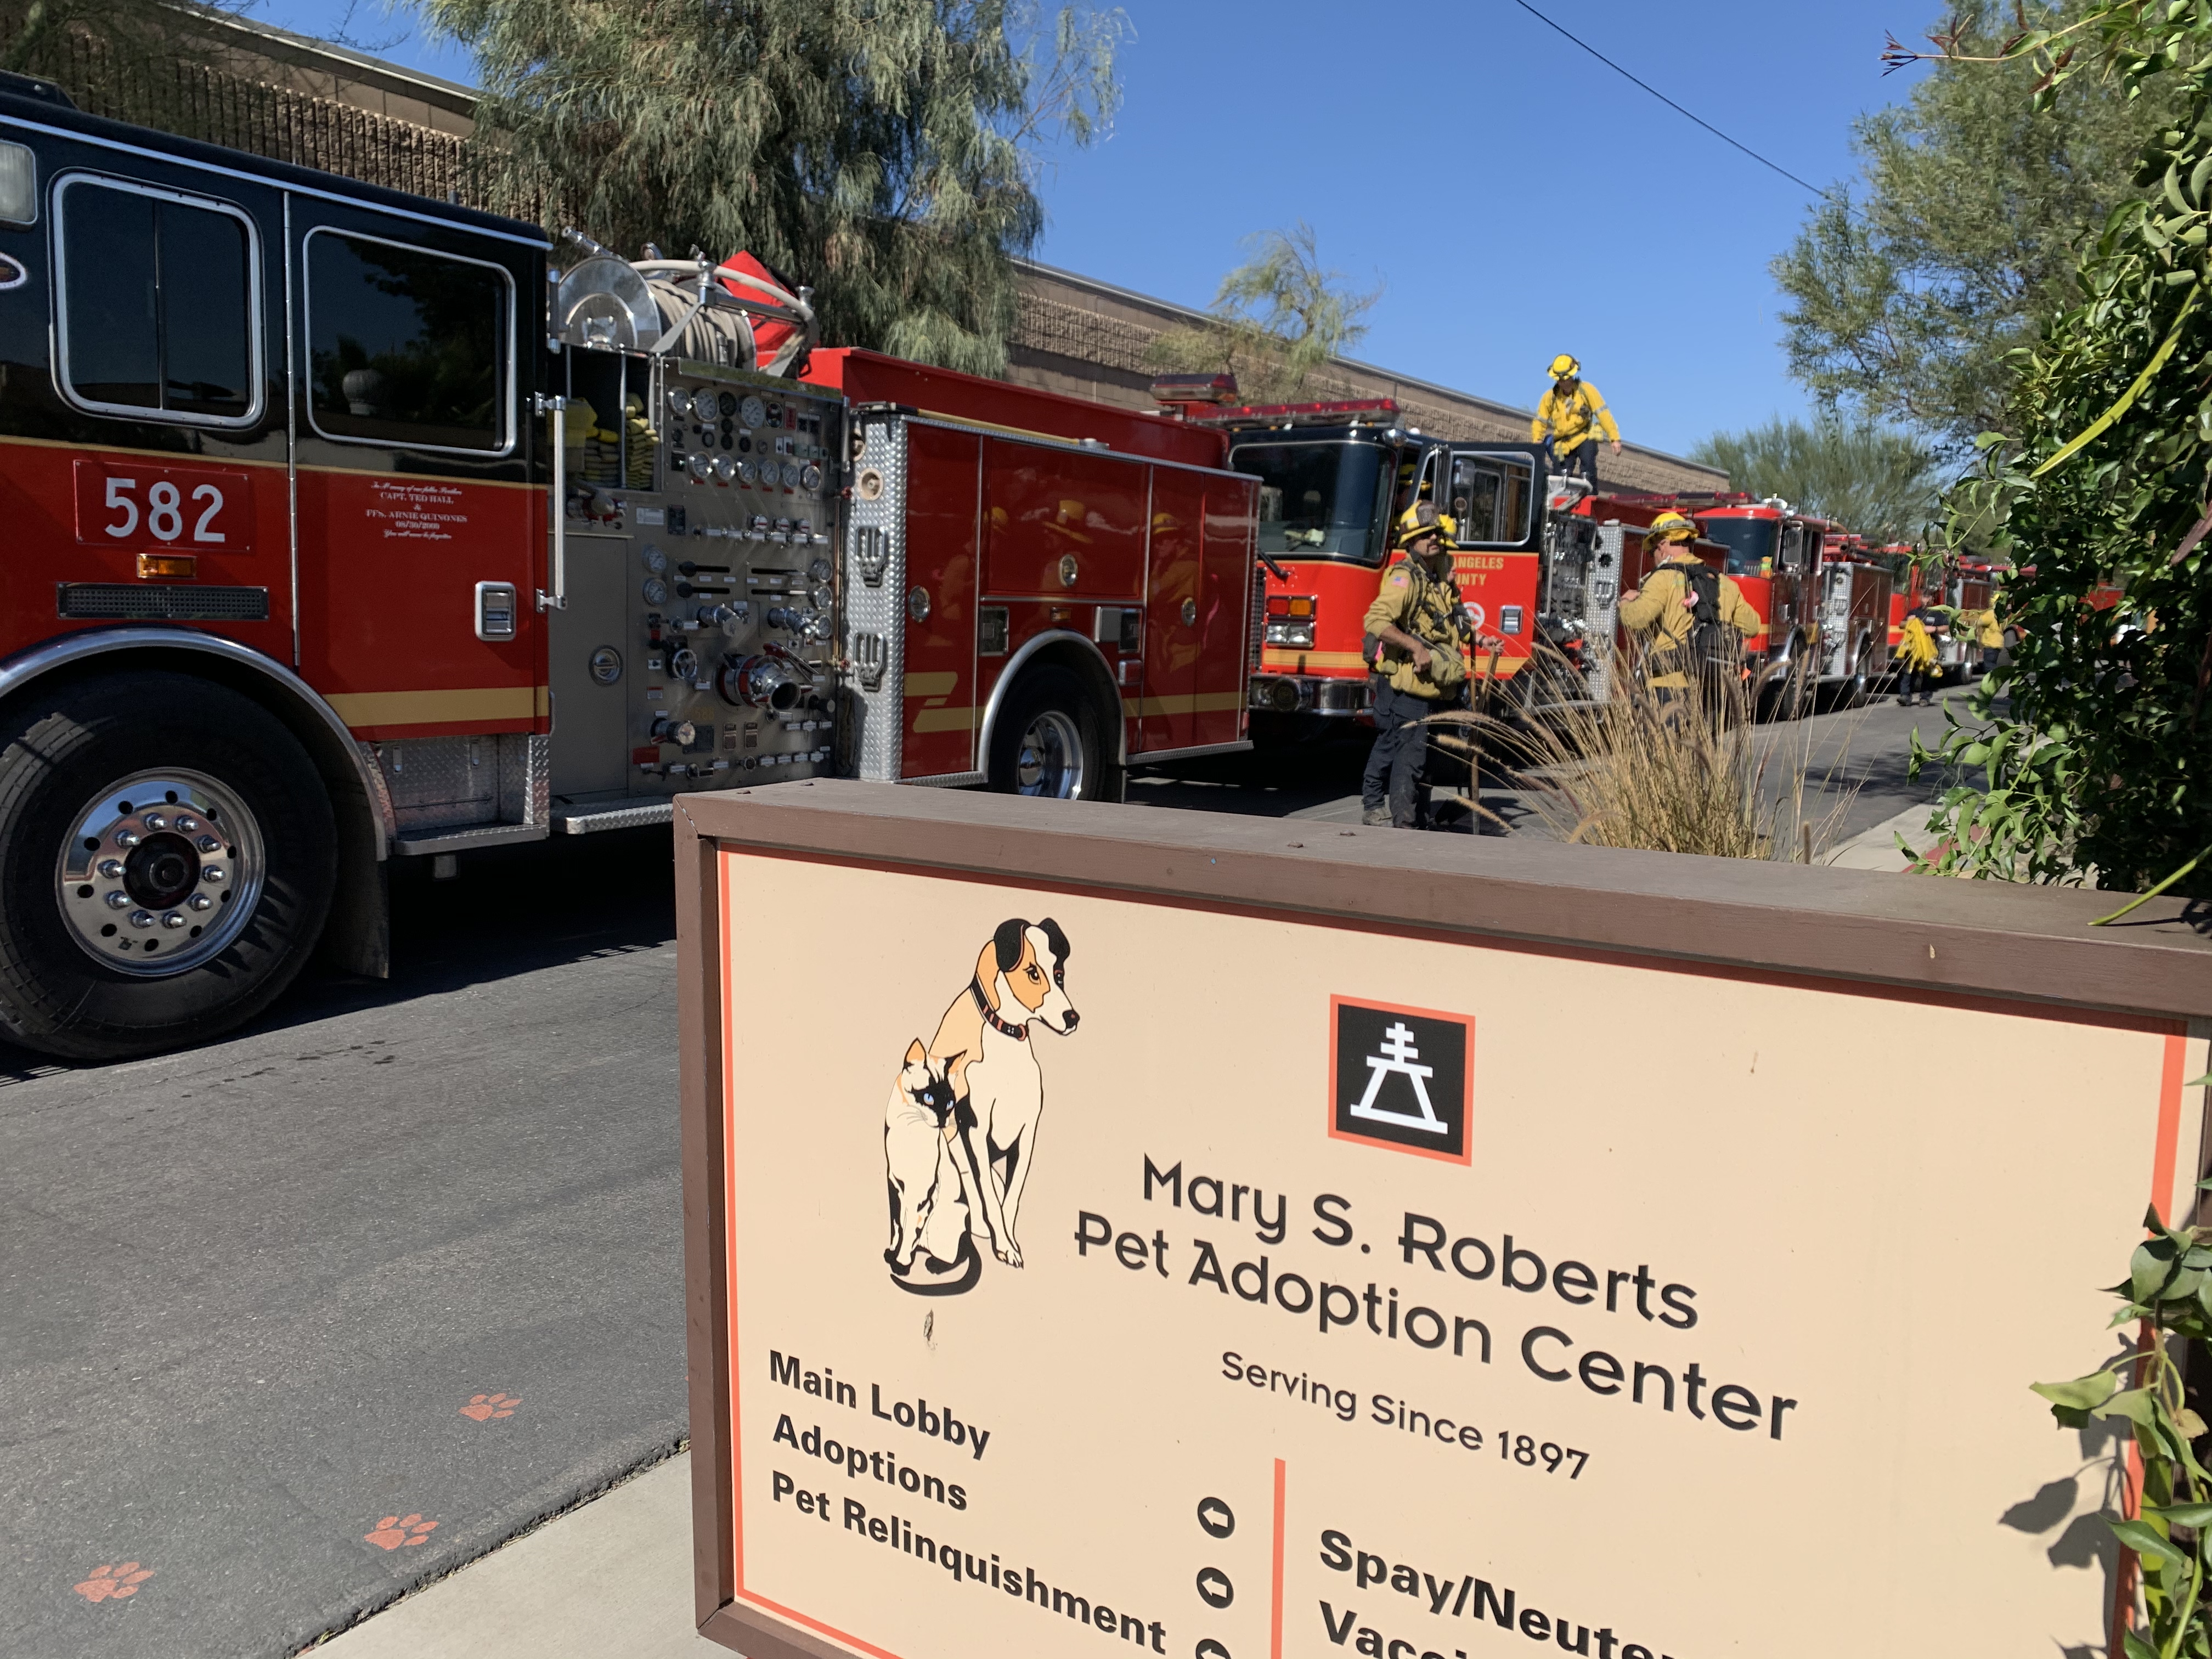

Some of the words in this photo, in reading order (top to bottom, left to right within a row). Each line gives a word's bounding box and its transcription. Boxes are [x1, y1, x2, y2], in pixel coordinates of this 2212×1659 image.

[105, 477, 225, 542] 582
[409, 493, 428, 503] TED
[1455, 573, 1487, 586] UNTY
[1144, 1153, 1286, 1244] Mary
[1312, 1194, 1370, 1254] S.
[1398, 1212, 1698, 1329] Roberts
[1074, 1210, 1170, 1278] Pet
[1188, 1239, 1491, 1363] Adoption
[1521, 1326, 1797, 1440] Center
[770, 1349, 856, 1409] Main
[872, 1383, 991, 1460] Lobby
[772, 1413, 967, 1511] Adoptions
[1222, 1352, 1356, 1421] Serving
[1371, 1395, 1483, 1450] Since
[1498, 1431, 1590, 1480] 1897
[773, 1470, 830, 1522] Pet
[844, 1497, 1166, 1655] Relinquishment
[1320, 1530, 1675, 1659] Spay/Neut
